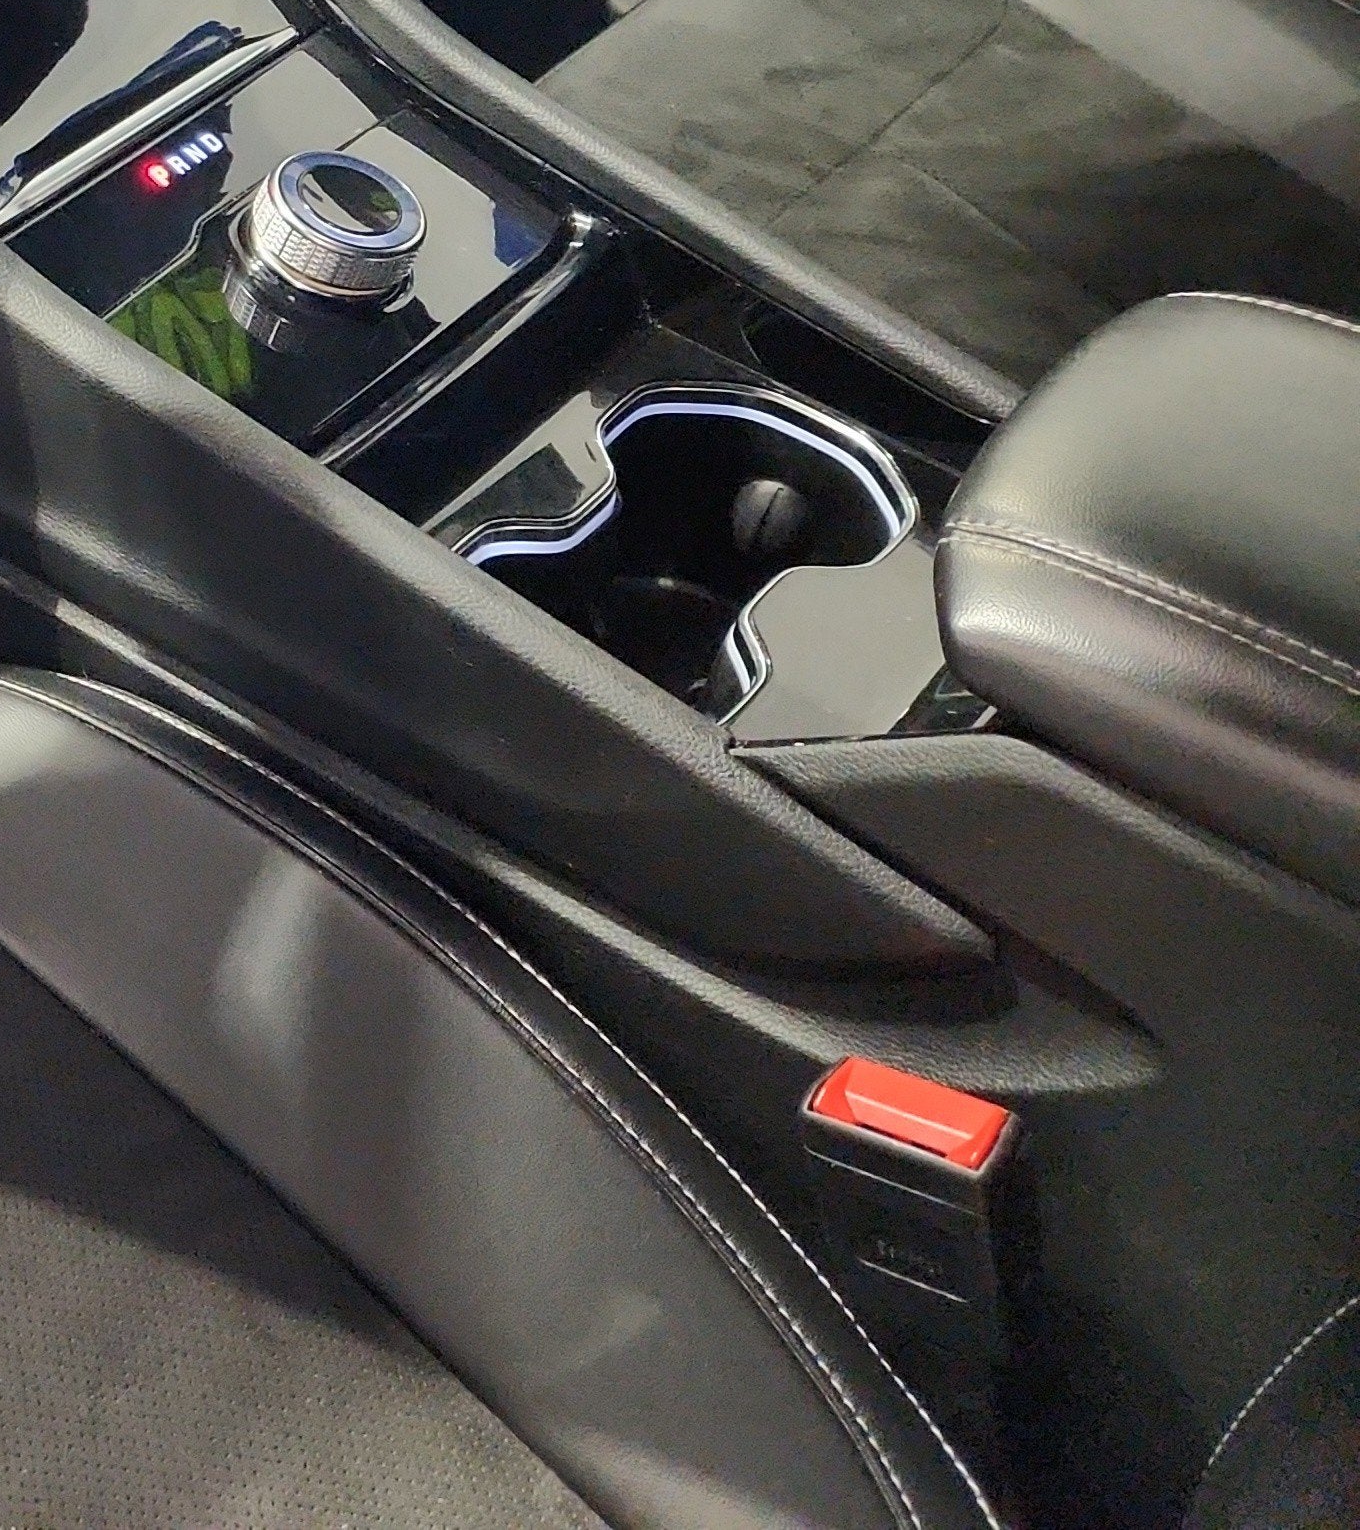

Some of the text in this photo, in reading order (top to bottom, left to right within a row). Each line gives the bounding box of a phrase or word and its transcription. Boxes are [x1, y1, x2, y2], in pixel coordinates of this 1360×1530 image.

[148, 133, 223, 187] P R N D
